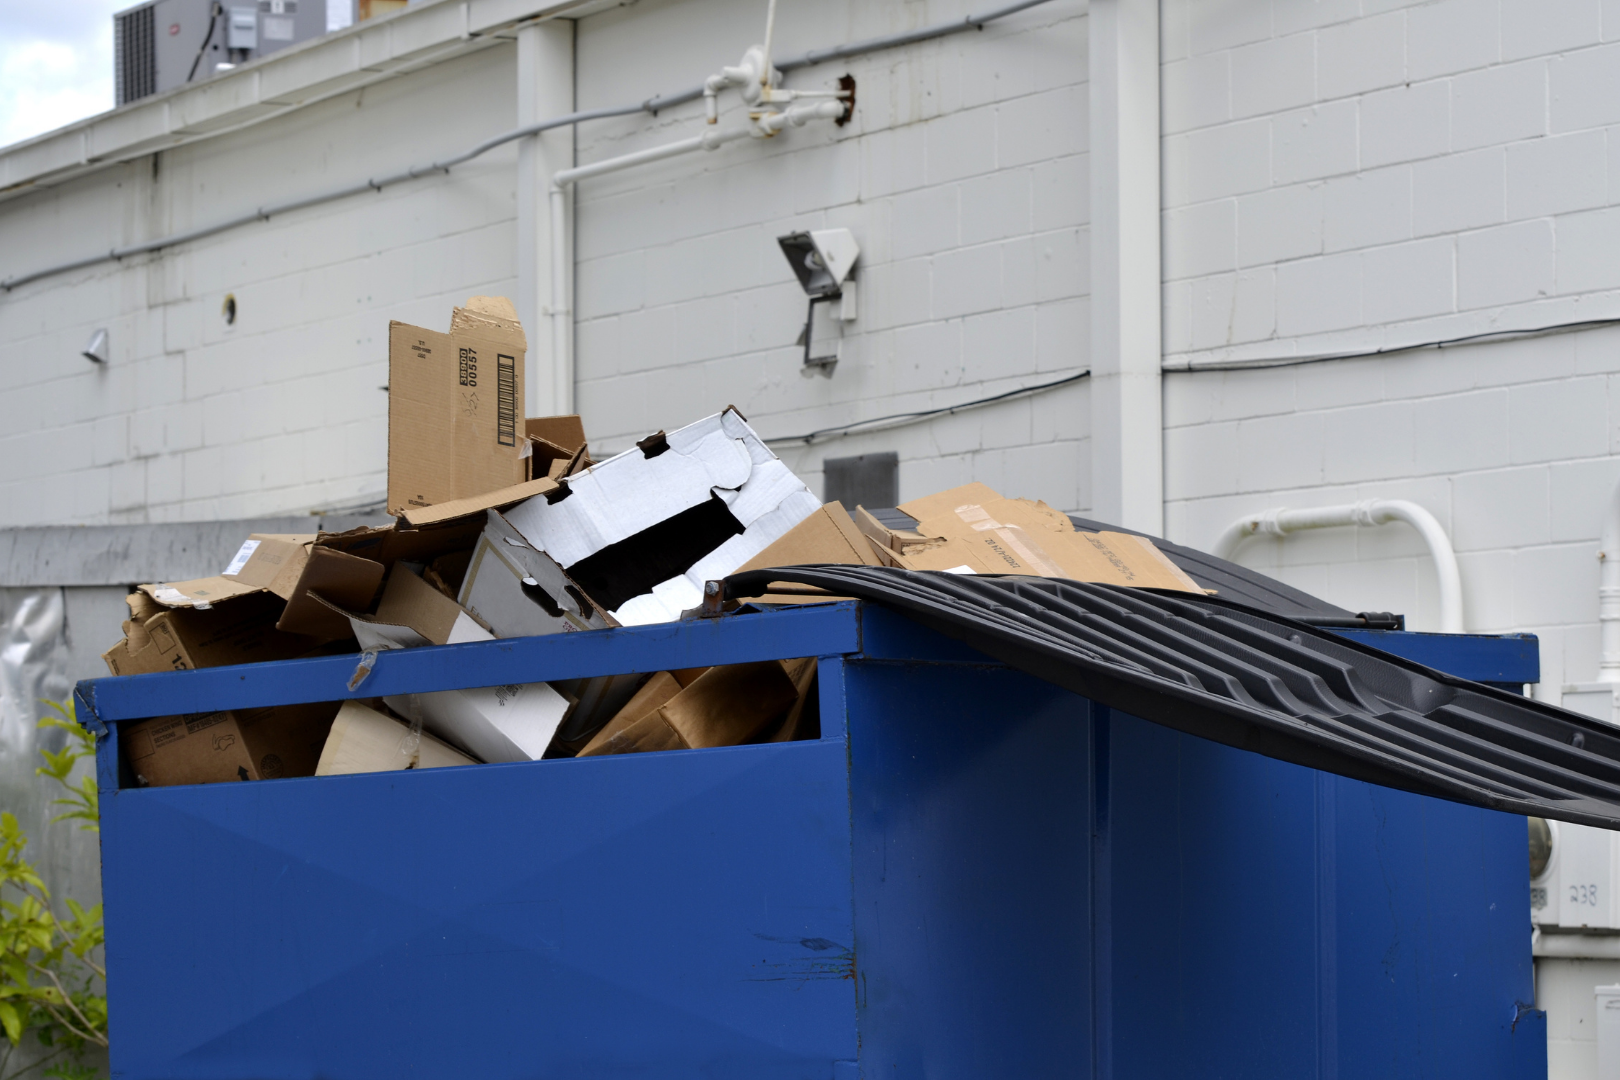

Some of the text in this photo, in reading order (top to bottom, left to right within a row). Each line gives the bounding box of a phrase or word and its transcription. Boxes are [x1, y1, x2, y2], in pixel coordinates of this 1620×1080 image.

[460, 349, 468, 385] 38900
[468, 348, 477, 387] 00557
[154, 731, 176, 744] SECTIONS
[1569, 884, 1598, 907] 238
